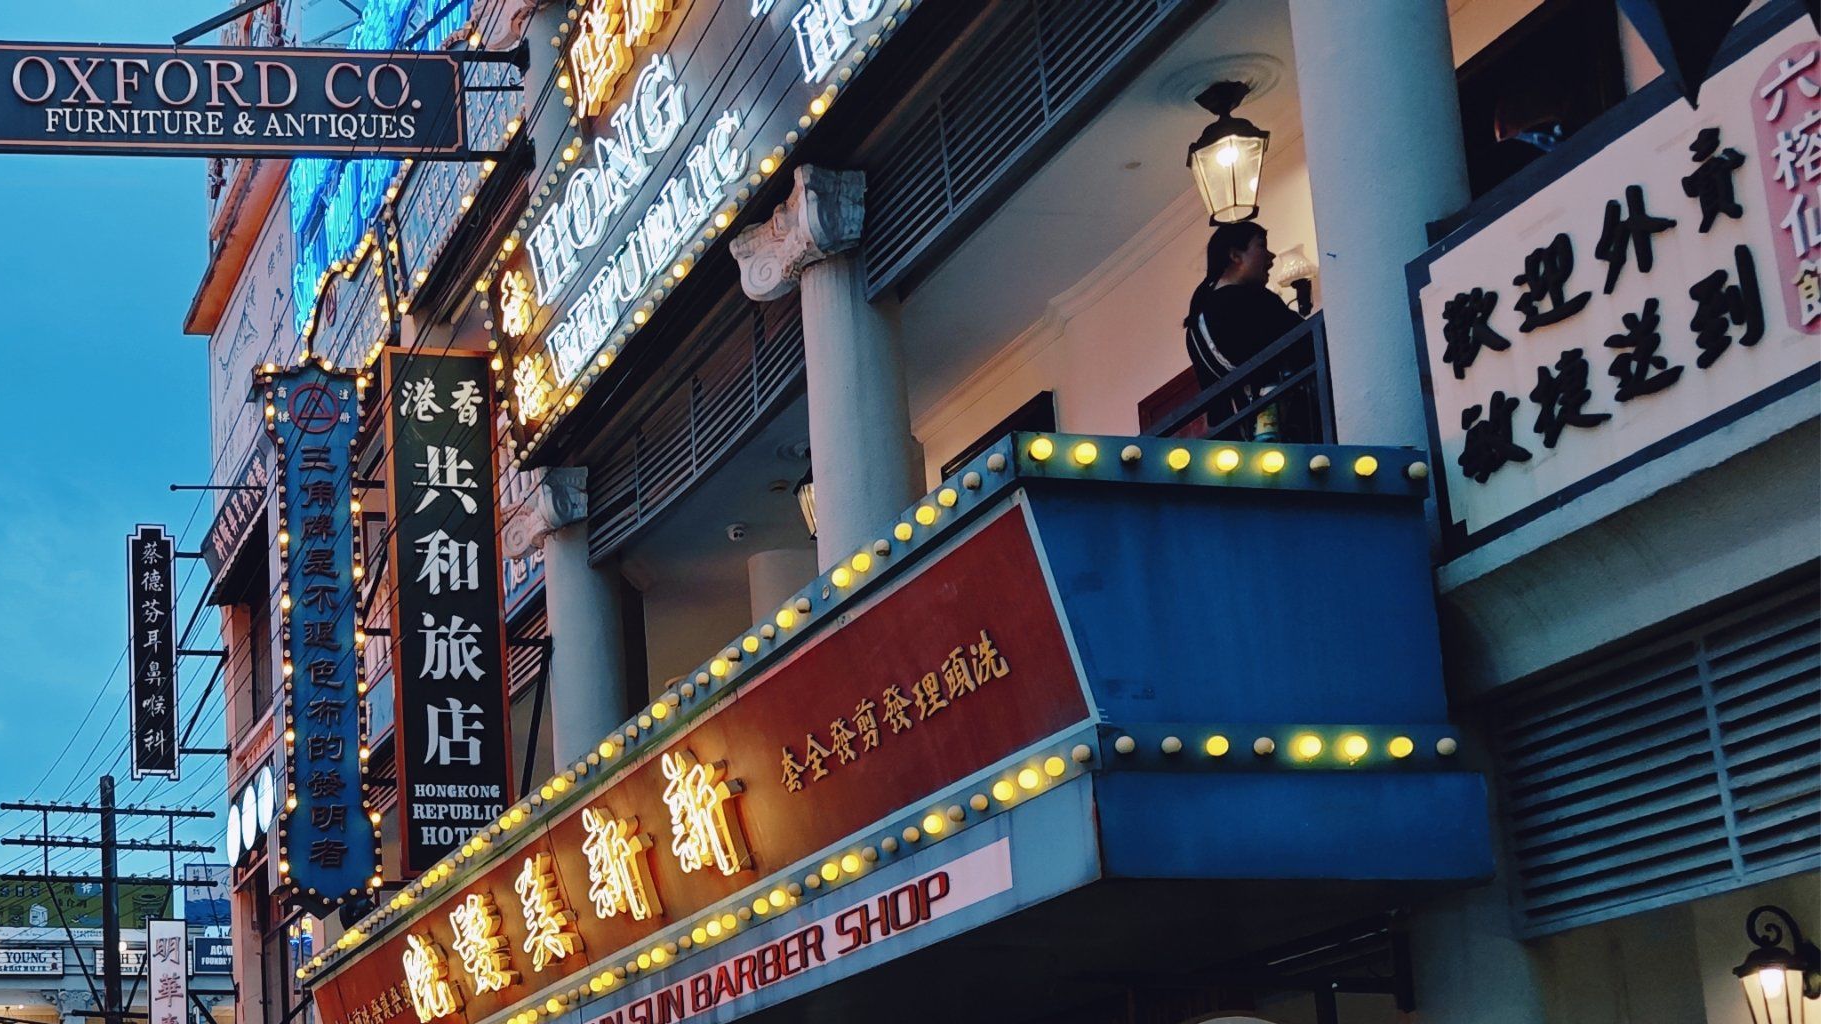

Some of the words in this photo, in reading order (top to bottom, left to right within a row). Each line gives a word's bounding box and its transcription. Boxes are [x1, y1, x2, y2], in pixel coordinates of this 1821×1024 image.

[11, 56, 298, 109] OXFORD
[324, 61, 422, 110] CO.
[45, 107, 224, 138] FURNITURE
[233, 111, 256, 136] &
[263, 112, 416, 140] ANTIQUES
[526, 53, 688, 306] HONG
[412, 444, 486, 767] 共和旅店
[140, 541, 167, 757] 蔡德芬耳鼻喉科
[412, 802, 505, 822] REPUBLIC
[414, 782, 500, 800] HONGKONG
[6, 951, 47, 963] YOUNG
[691, 926, 825, 1011] BARBER
[836, 870, 950, 952] SHOP
